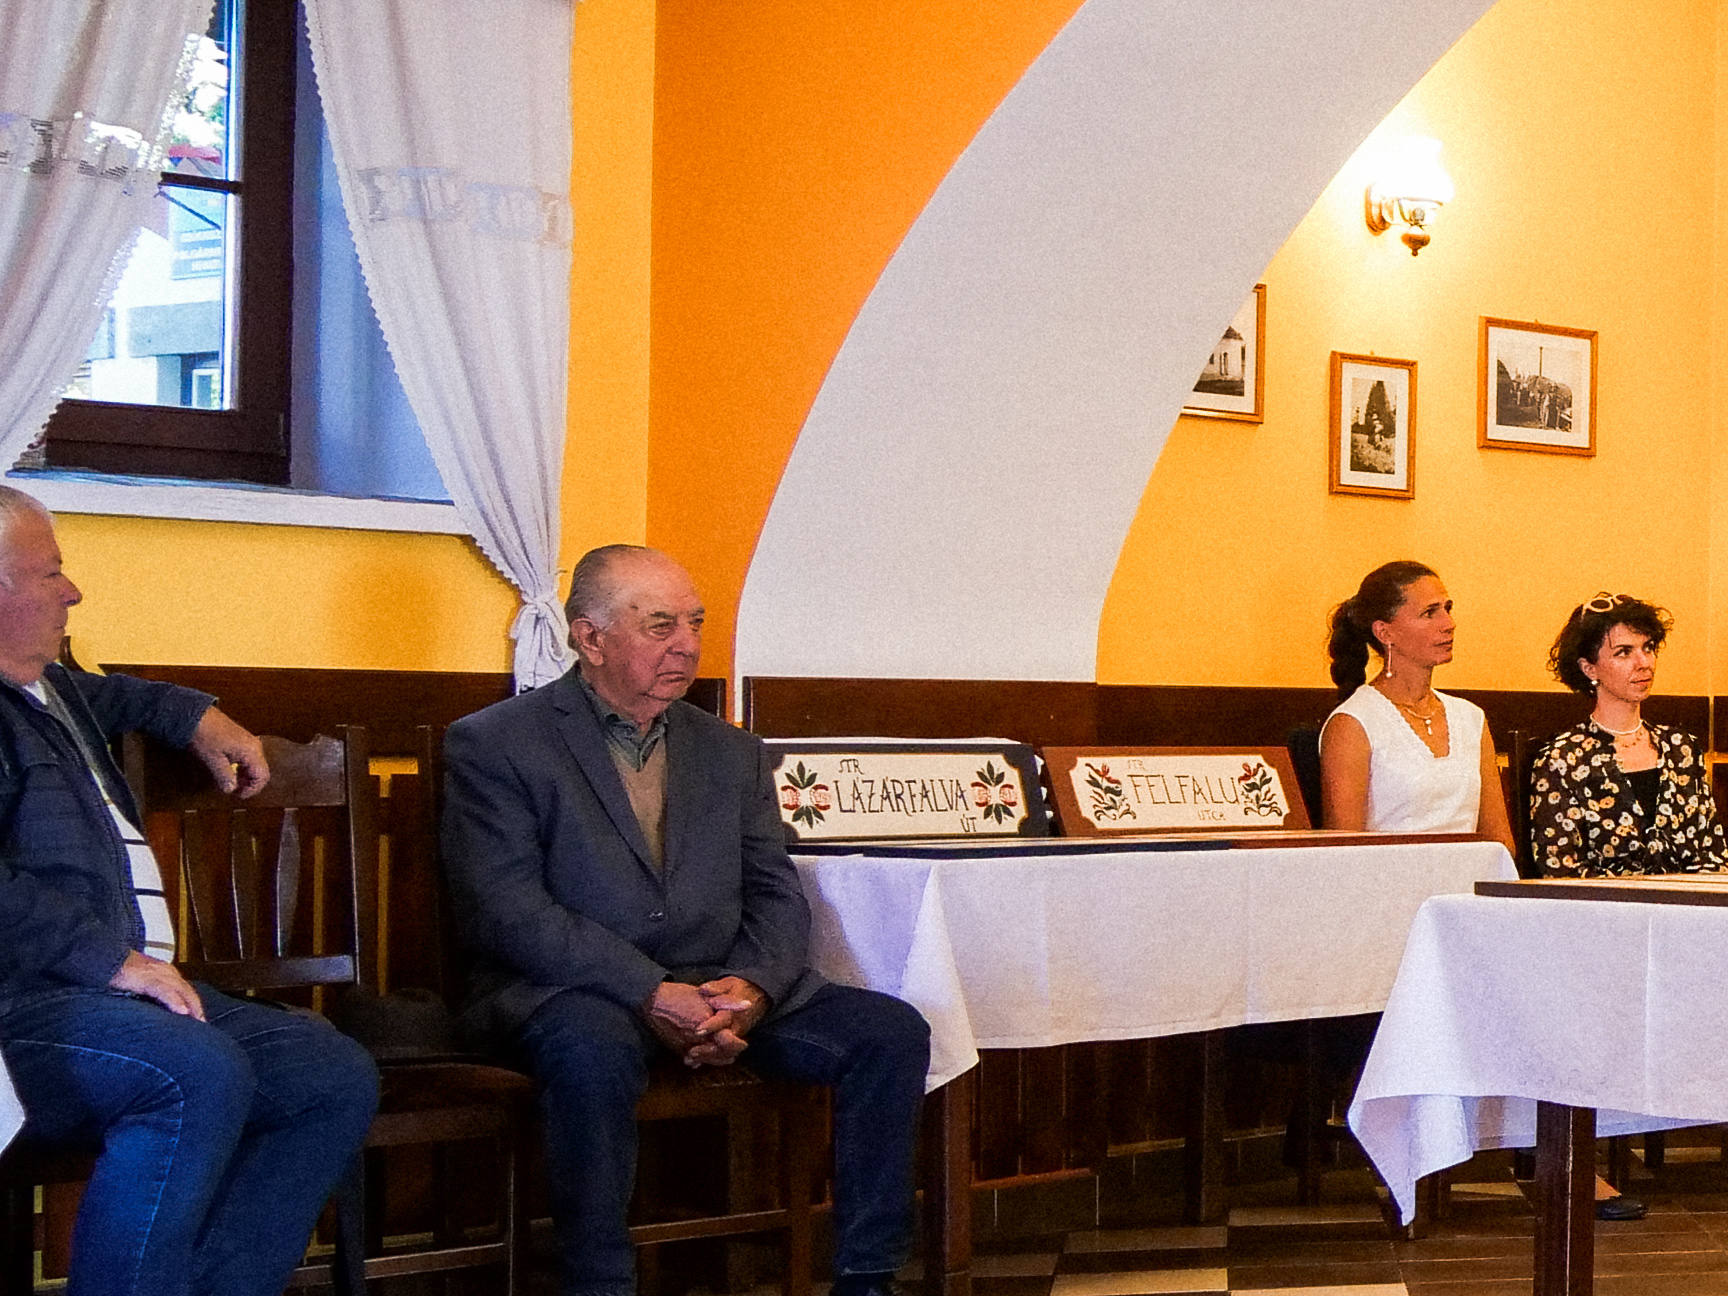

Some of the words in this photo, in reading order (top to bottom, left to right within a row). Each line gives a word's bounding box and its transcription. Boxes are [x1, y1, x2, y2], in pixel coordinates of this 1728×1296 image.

[838, 758, 865, 775] STR
[1127, 759, 1146, 771] STR
[833, 776, 970, 817] LÁZÁRFALVA
[1127, 774, 1241, 805] FELFALU
[960, 813, 978, 833] ÚT
